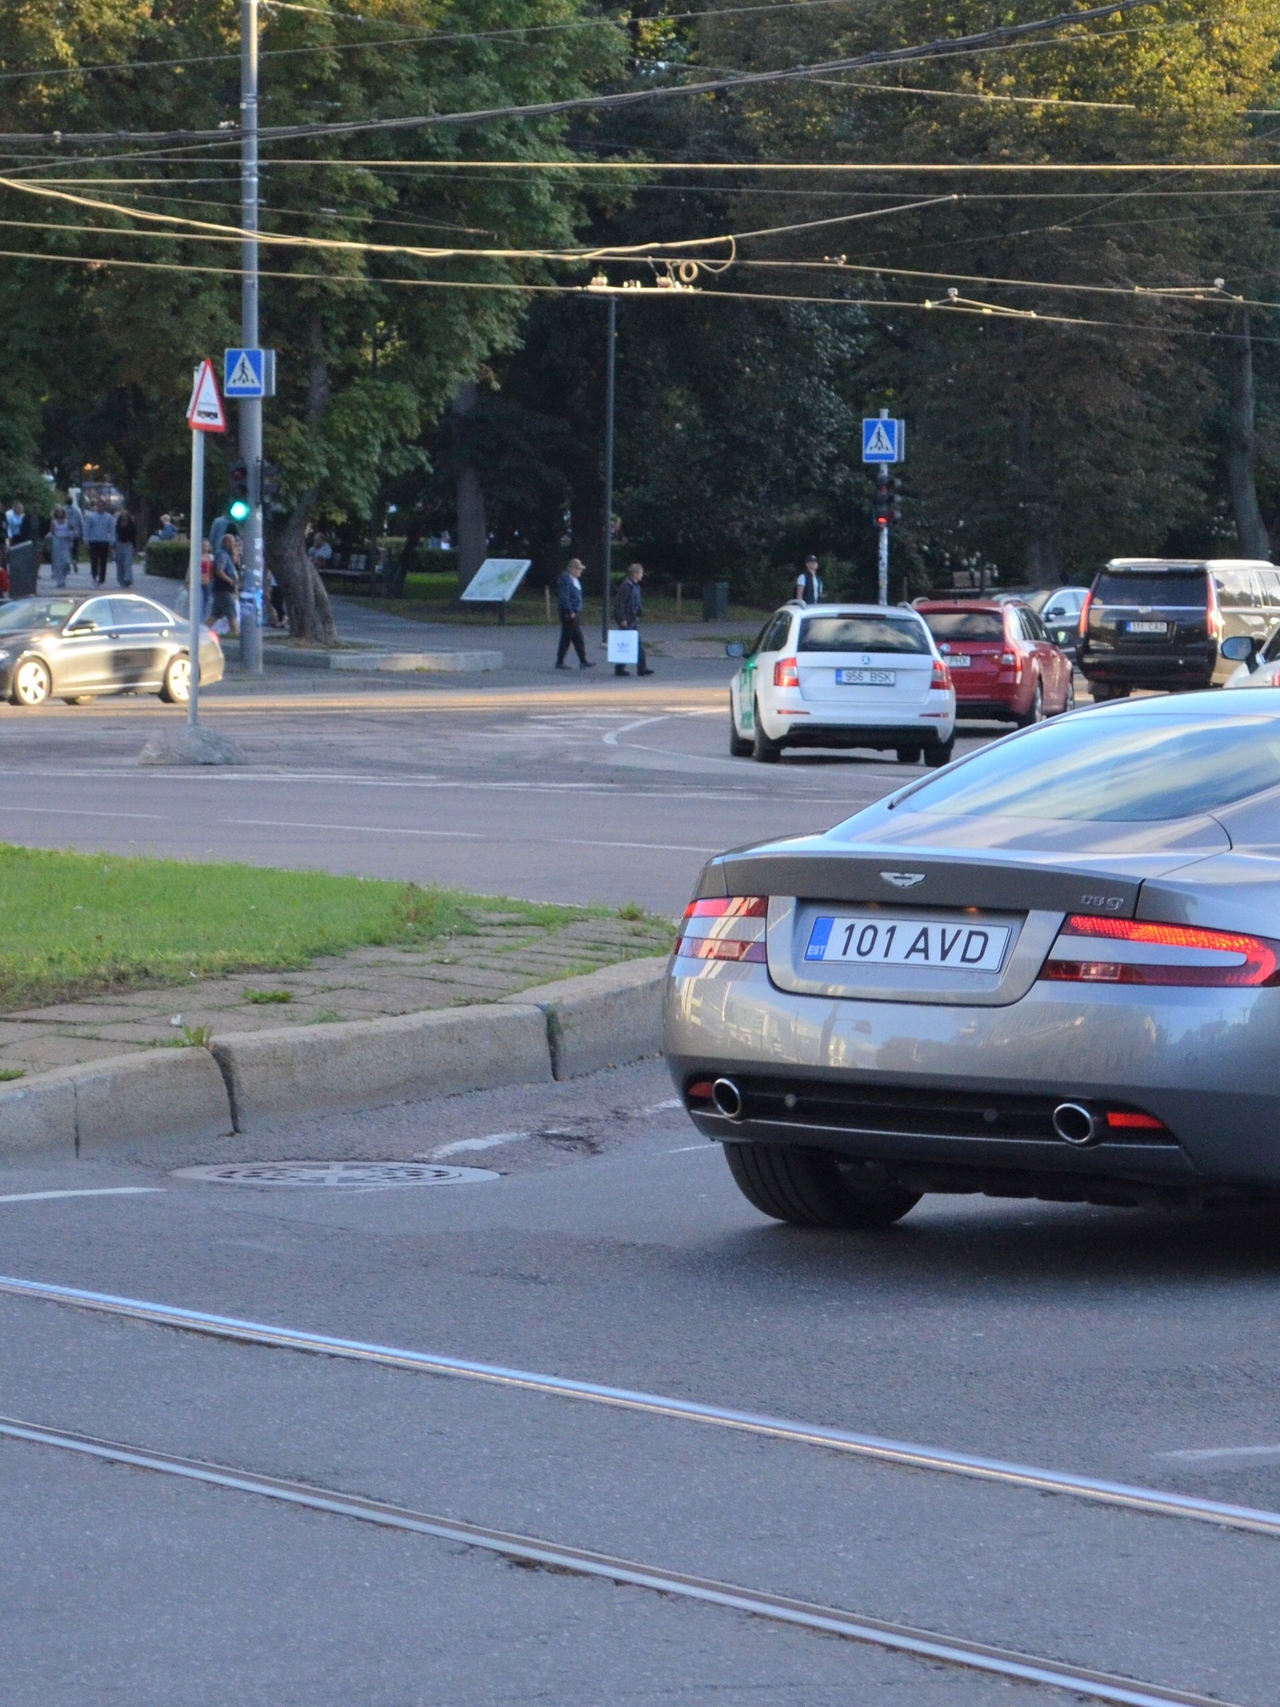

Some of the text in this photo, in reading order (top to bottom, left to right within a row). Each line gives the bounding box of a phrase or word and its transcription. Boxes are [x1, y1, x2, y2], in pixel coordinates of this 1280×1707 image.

[845, 671, 891, 682] 956 BSK
[1080, 895, 1124, 911] DB9
[842, 923, 989, 964] 101 AVD
[807, 945, 825, 956] EST
